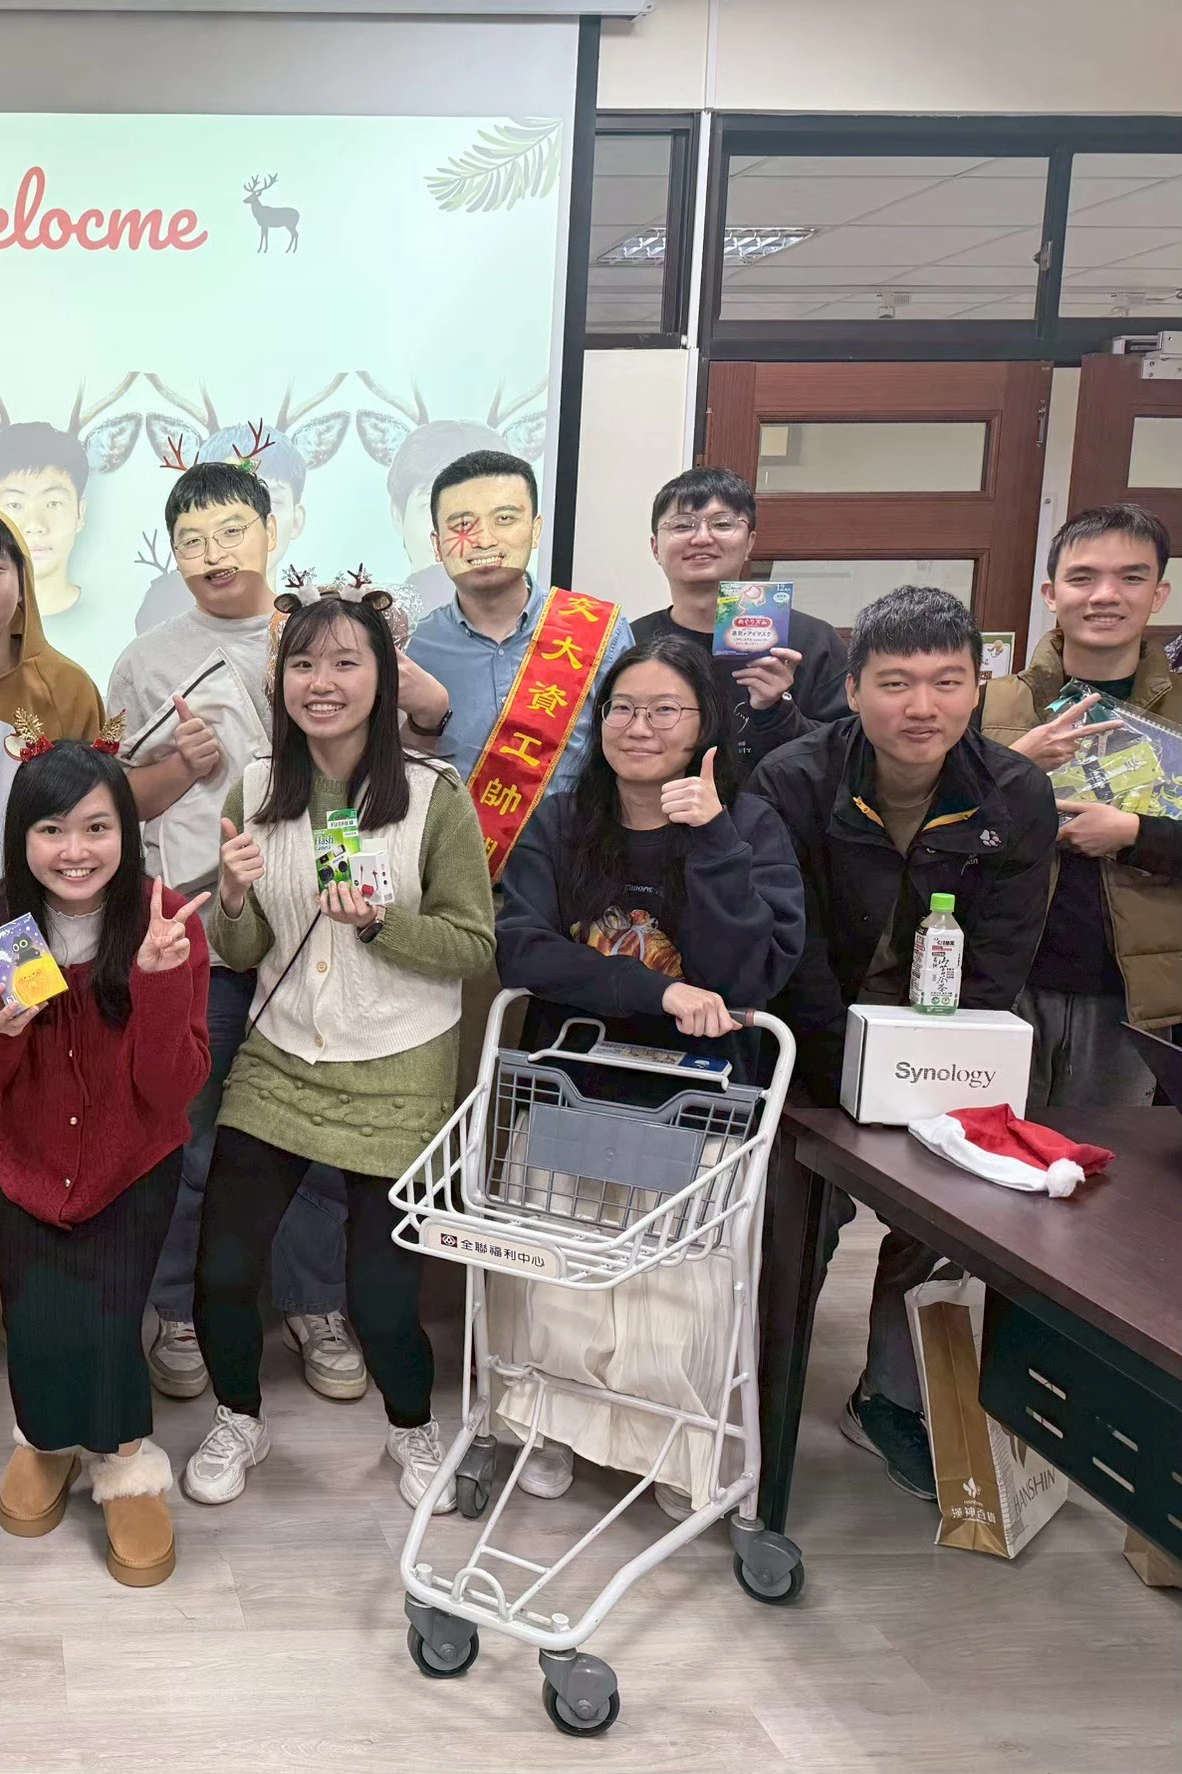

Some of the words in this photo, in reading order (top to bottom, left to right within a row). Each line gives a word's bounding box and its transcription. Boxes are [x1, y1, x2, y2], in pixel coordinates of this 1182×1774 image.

[894, 1061, 997, 1089] Synology
[460, 1239, 545, 1267] 全聯福利中心
[1013, 1468, 1056, 1514] HANSHIN
